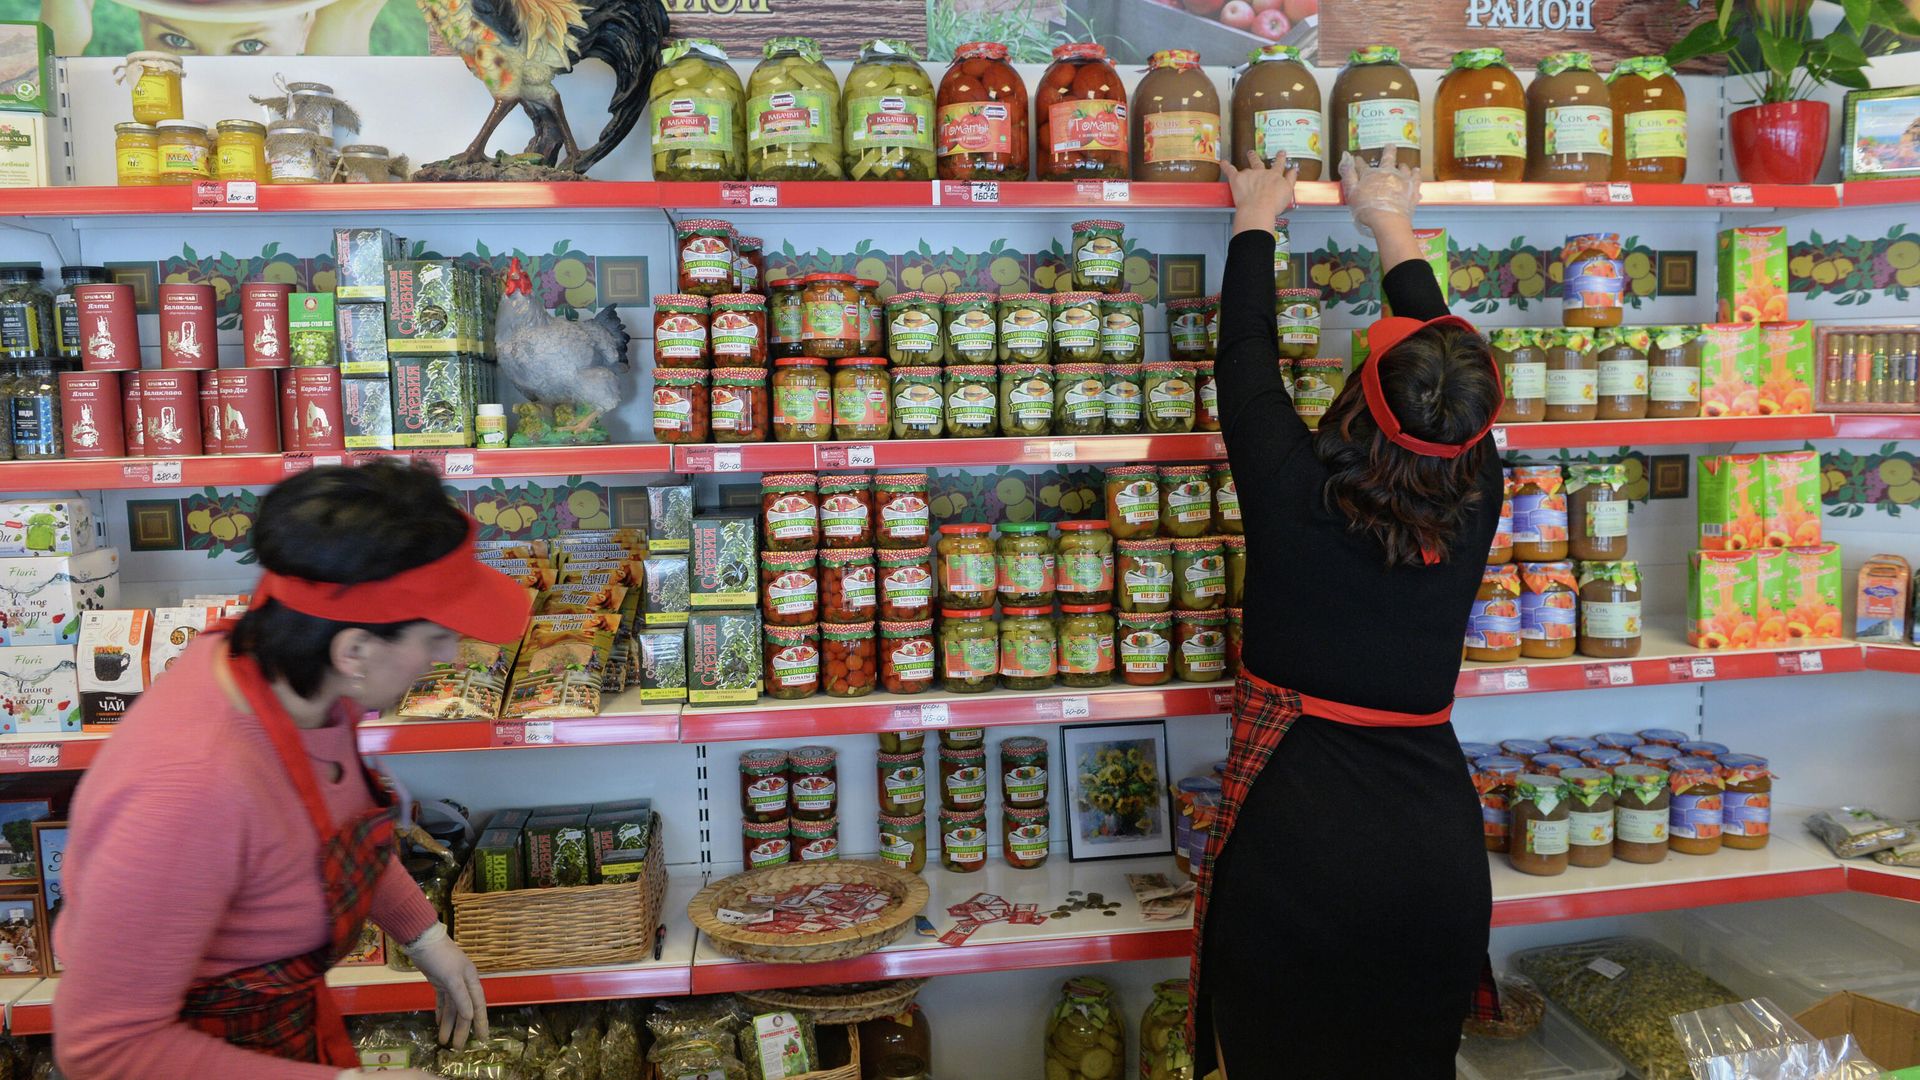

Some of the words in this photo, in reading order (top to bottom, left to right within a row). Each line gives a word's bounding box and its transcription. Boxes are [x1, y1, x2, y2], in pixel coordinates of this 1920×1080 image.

[768, 112, 800, 121] КАБАЧКИ
[1361, 107, 1384, 118] Сок
[667, 118, 698, 127] КАБАЧКИ
[876, 115, 909, 124] КАБАЧКИ
[1268, 117, 1292, 128] Сок
[1559, 114, 1583, 123] Сок
[98, 699, 125, 712] ЧАЙ
